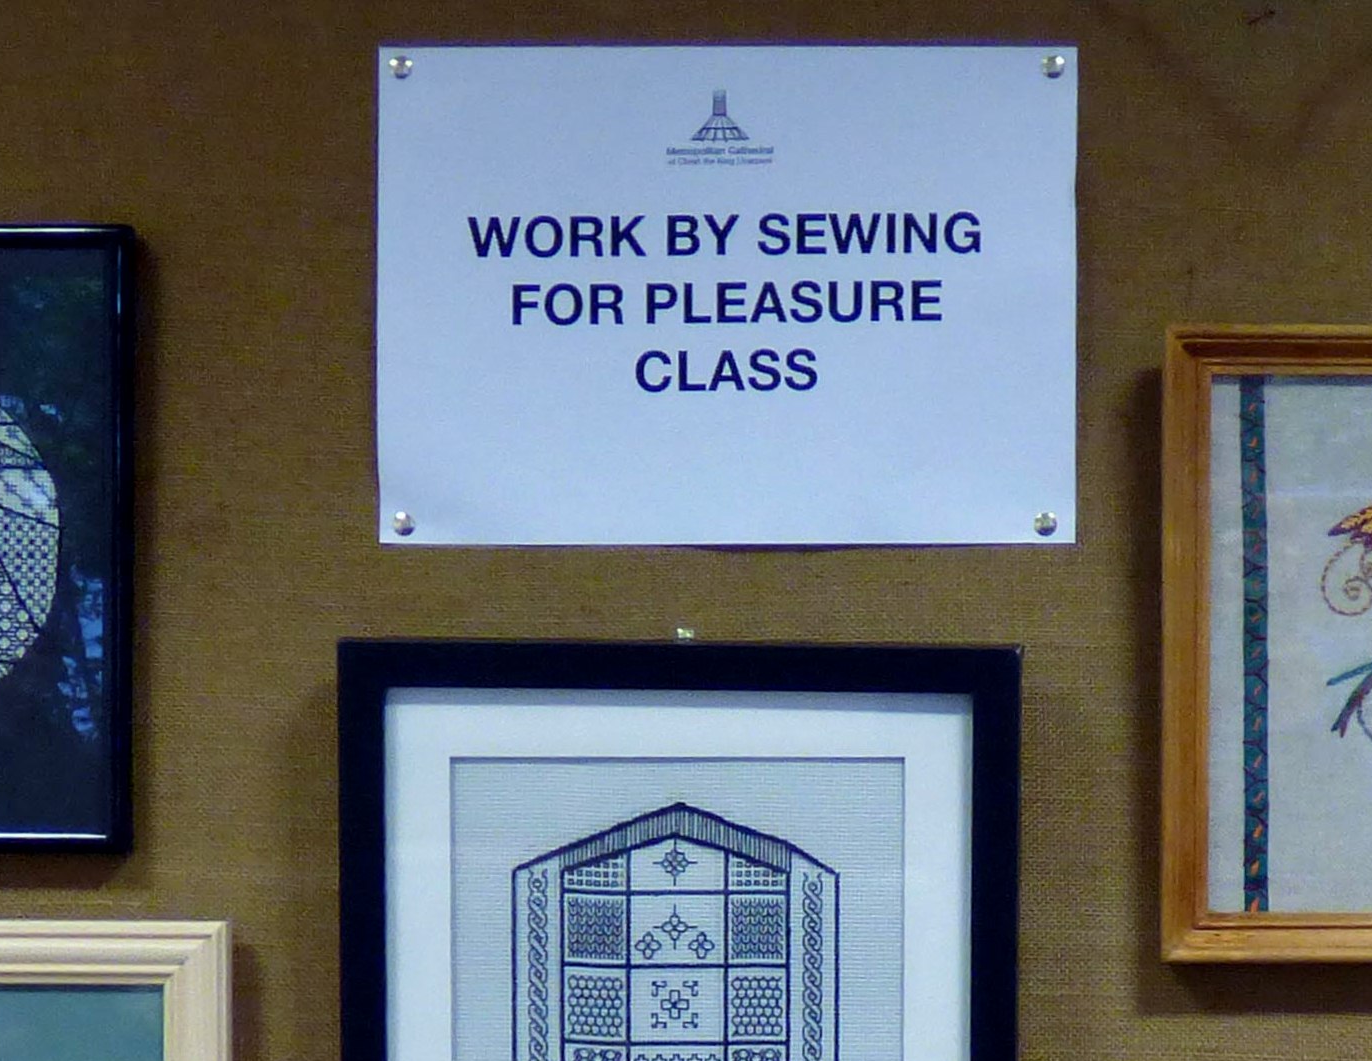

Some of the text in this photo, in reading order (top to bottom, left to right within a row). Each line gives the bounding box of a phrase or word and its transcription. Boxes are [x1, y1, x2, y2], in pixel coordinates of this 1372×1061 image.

[467, 211, 982, 260] WORK BY SEWING
[512, 280, 943, 326] FOR PLEASURE
[634, 348, 819, 393] CLASS
